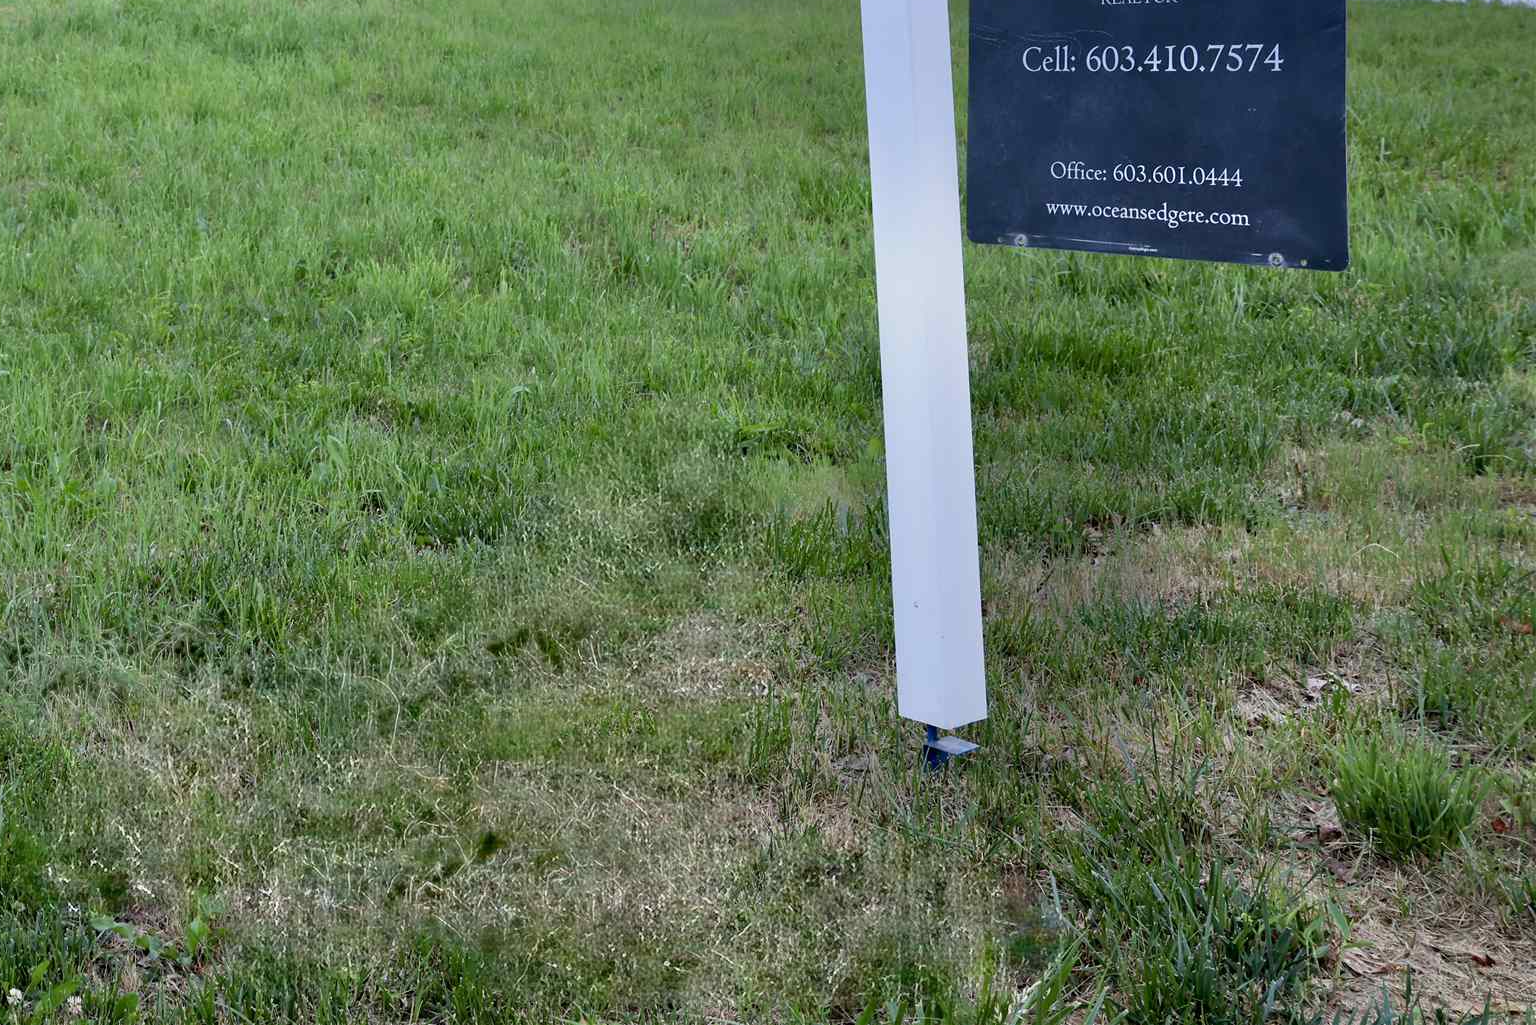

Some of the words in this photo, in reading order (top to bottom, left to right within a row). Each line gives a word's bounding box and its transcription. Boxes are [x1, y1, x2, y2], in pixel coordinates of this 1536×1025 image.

[1022, 45, 1076, 73] Cell:
[1086, 43, 1284, 73] 603.410.7574
[1050, 160, 1107, 182] Office:
[1112, 163, 1243, 187] 603.601.0444
[1046, 202, 1250, 229] www.oceansedgere.com
